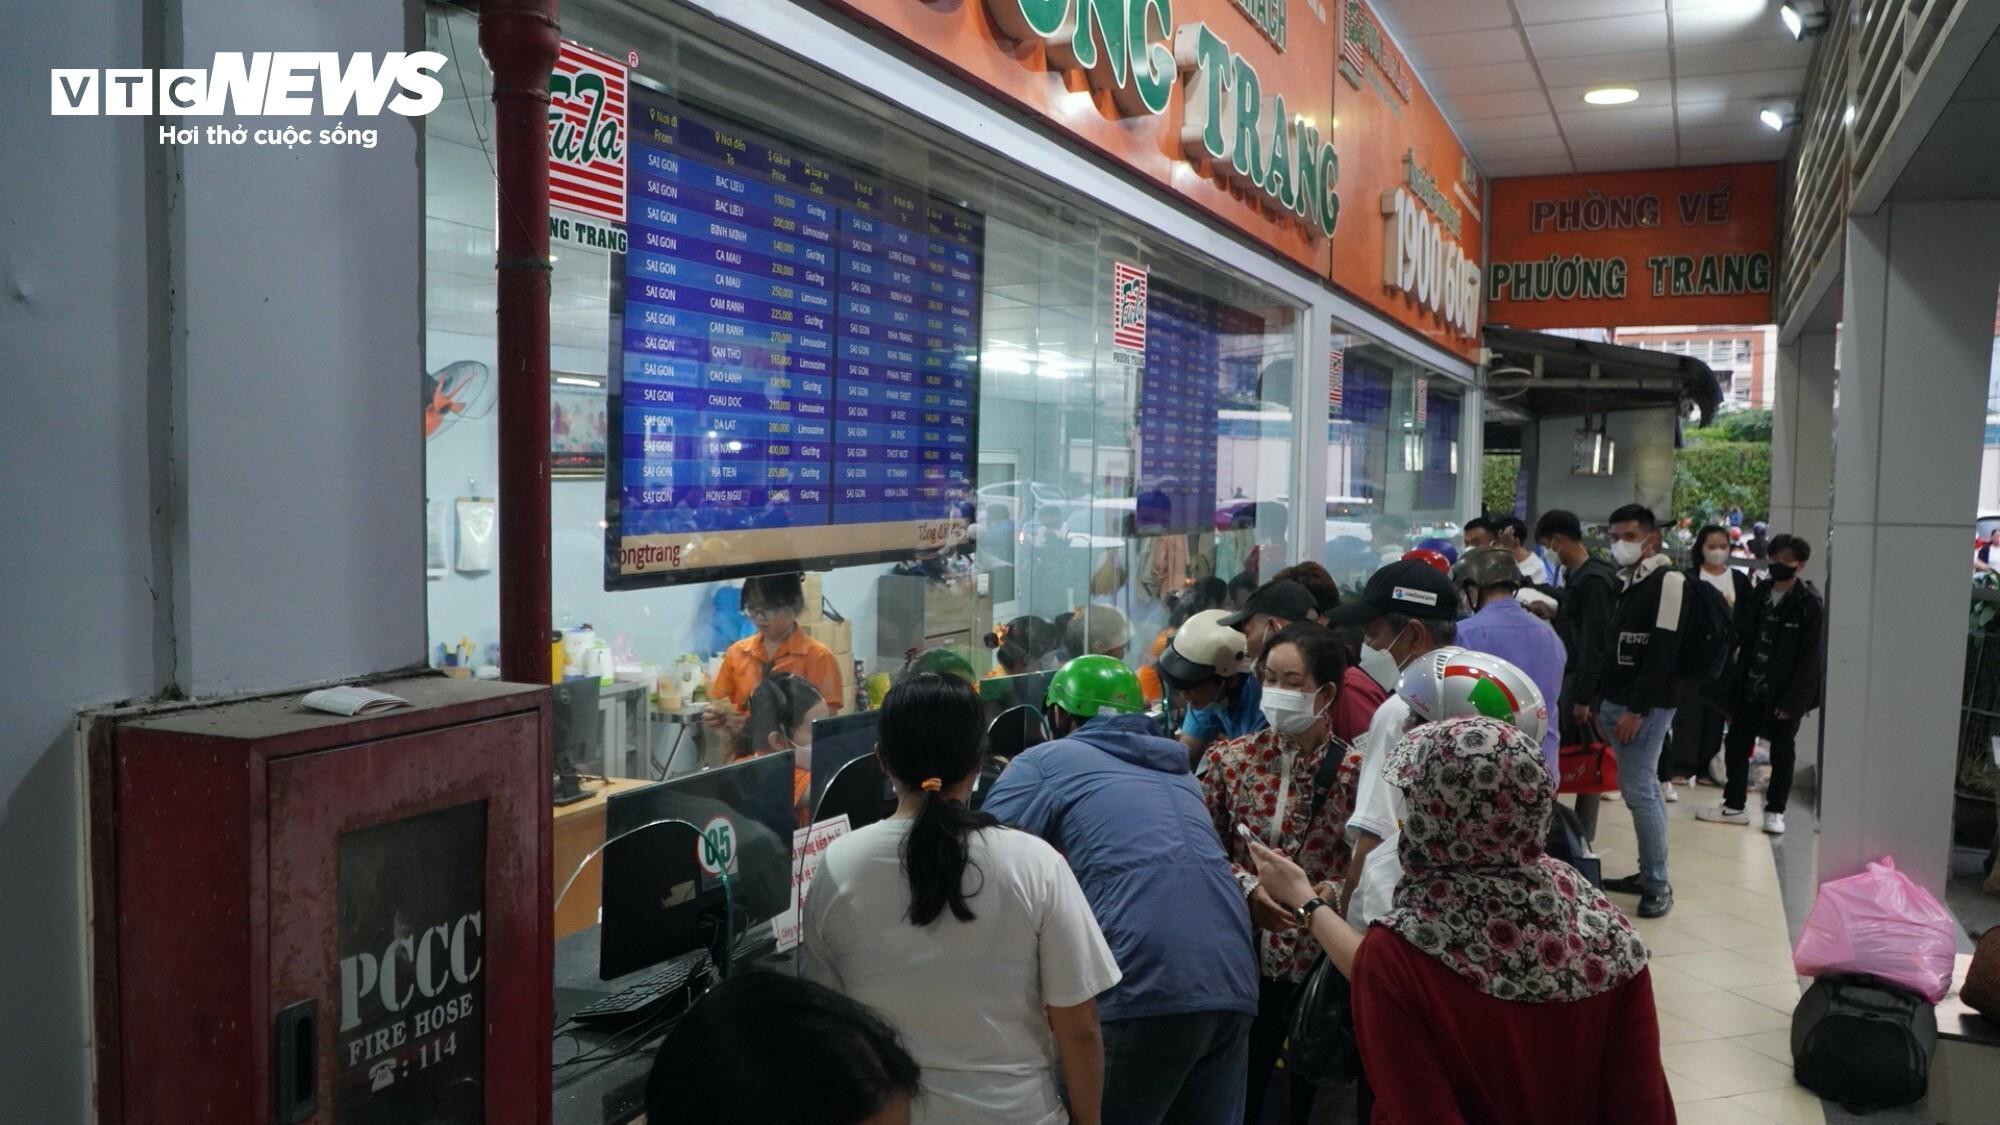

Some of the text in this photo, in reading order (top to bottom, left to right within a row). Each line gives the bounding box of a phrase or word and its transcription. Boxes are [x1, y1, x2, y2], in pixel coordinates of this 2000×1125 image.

[1198, 20, 1340, 238] TRANG
[654, 129, 672, 144] From
[649, 154, 678, 174] SAI GON
[726, 154, 734, 165] To
[648, 181, 677, 199] SAI GON
[716, 176, 744, 193] BAC LIEU
[715, 200, 744, 217] BAC LIEU
[1532, 188, 1661, 232] PHÒNG
[648, 208, 677, 225] SAI GON
[575, 222, 627, 253] TRANG
[711, 224, 747, 243] BINH MINH
[803, 225, 829, 240] Limousine
[646, 234, 676, 250] SAI GON
[716, 250, 741, 264] CA MAU
[1395, 187, 1442, 313] 1900
[646, 260, 676, 276] SAI GON
[772, 263, 794, 277] 230,000
[716, 274, 740, 288] CA MAU
[1489, 252, 1771, 300] PHƯƠNG TRANG
[646, 286, 676, 300] SAI GON
[772, 286, 793, 299] 250,000
[801, 292, 827, 306] Limousine
[711, 298, 744, 313] CAM RANH
[645, 311, 675, 326] SAI GON
[771, 308, 793, 321] 225,000
[710, 322, 744, 336] CAM RANH
[645, 337, 675, 351] SAI GON
[800, 336, 826, 349] Limousine
[712, 346, 741, 360] CAN THO
[645, 363, 674, 377] SAI GON
[800, 358, 826, 370] Limousine
[710, 371, 742, 384] CAO LANH
[644, 390, 674, 402] SAI GON
[709, 395, 742, 407] CHAU DOC
[799, 402, 824, 414] Limousine
[714, 419, 736, 430] DA LAT
[798, 425, 824, 435] Limousine
[643, 467, 672, 478] SAI GON
[712, 467, 736, 478] HA TIEN
[643, 491, 672, 503] SAI GON
[706, 491, 742, 501] HONG NGU
[705, 825, 731, 866] 05
[340, 910, 481, 1033] PCCC
[348, 993, 473, 1067] FIRE HOSE
[419, 1031, 457, 1070] 114
